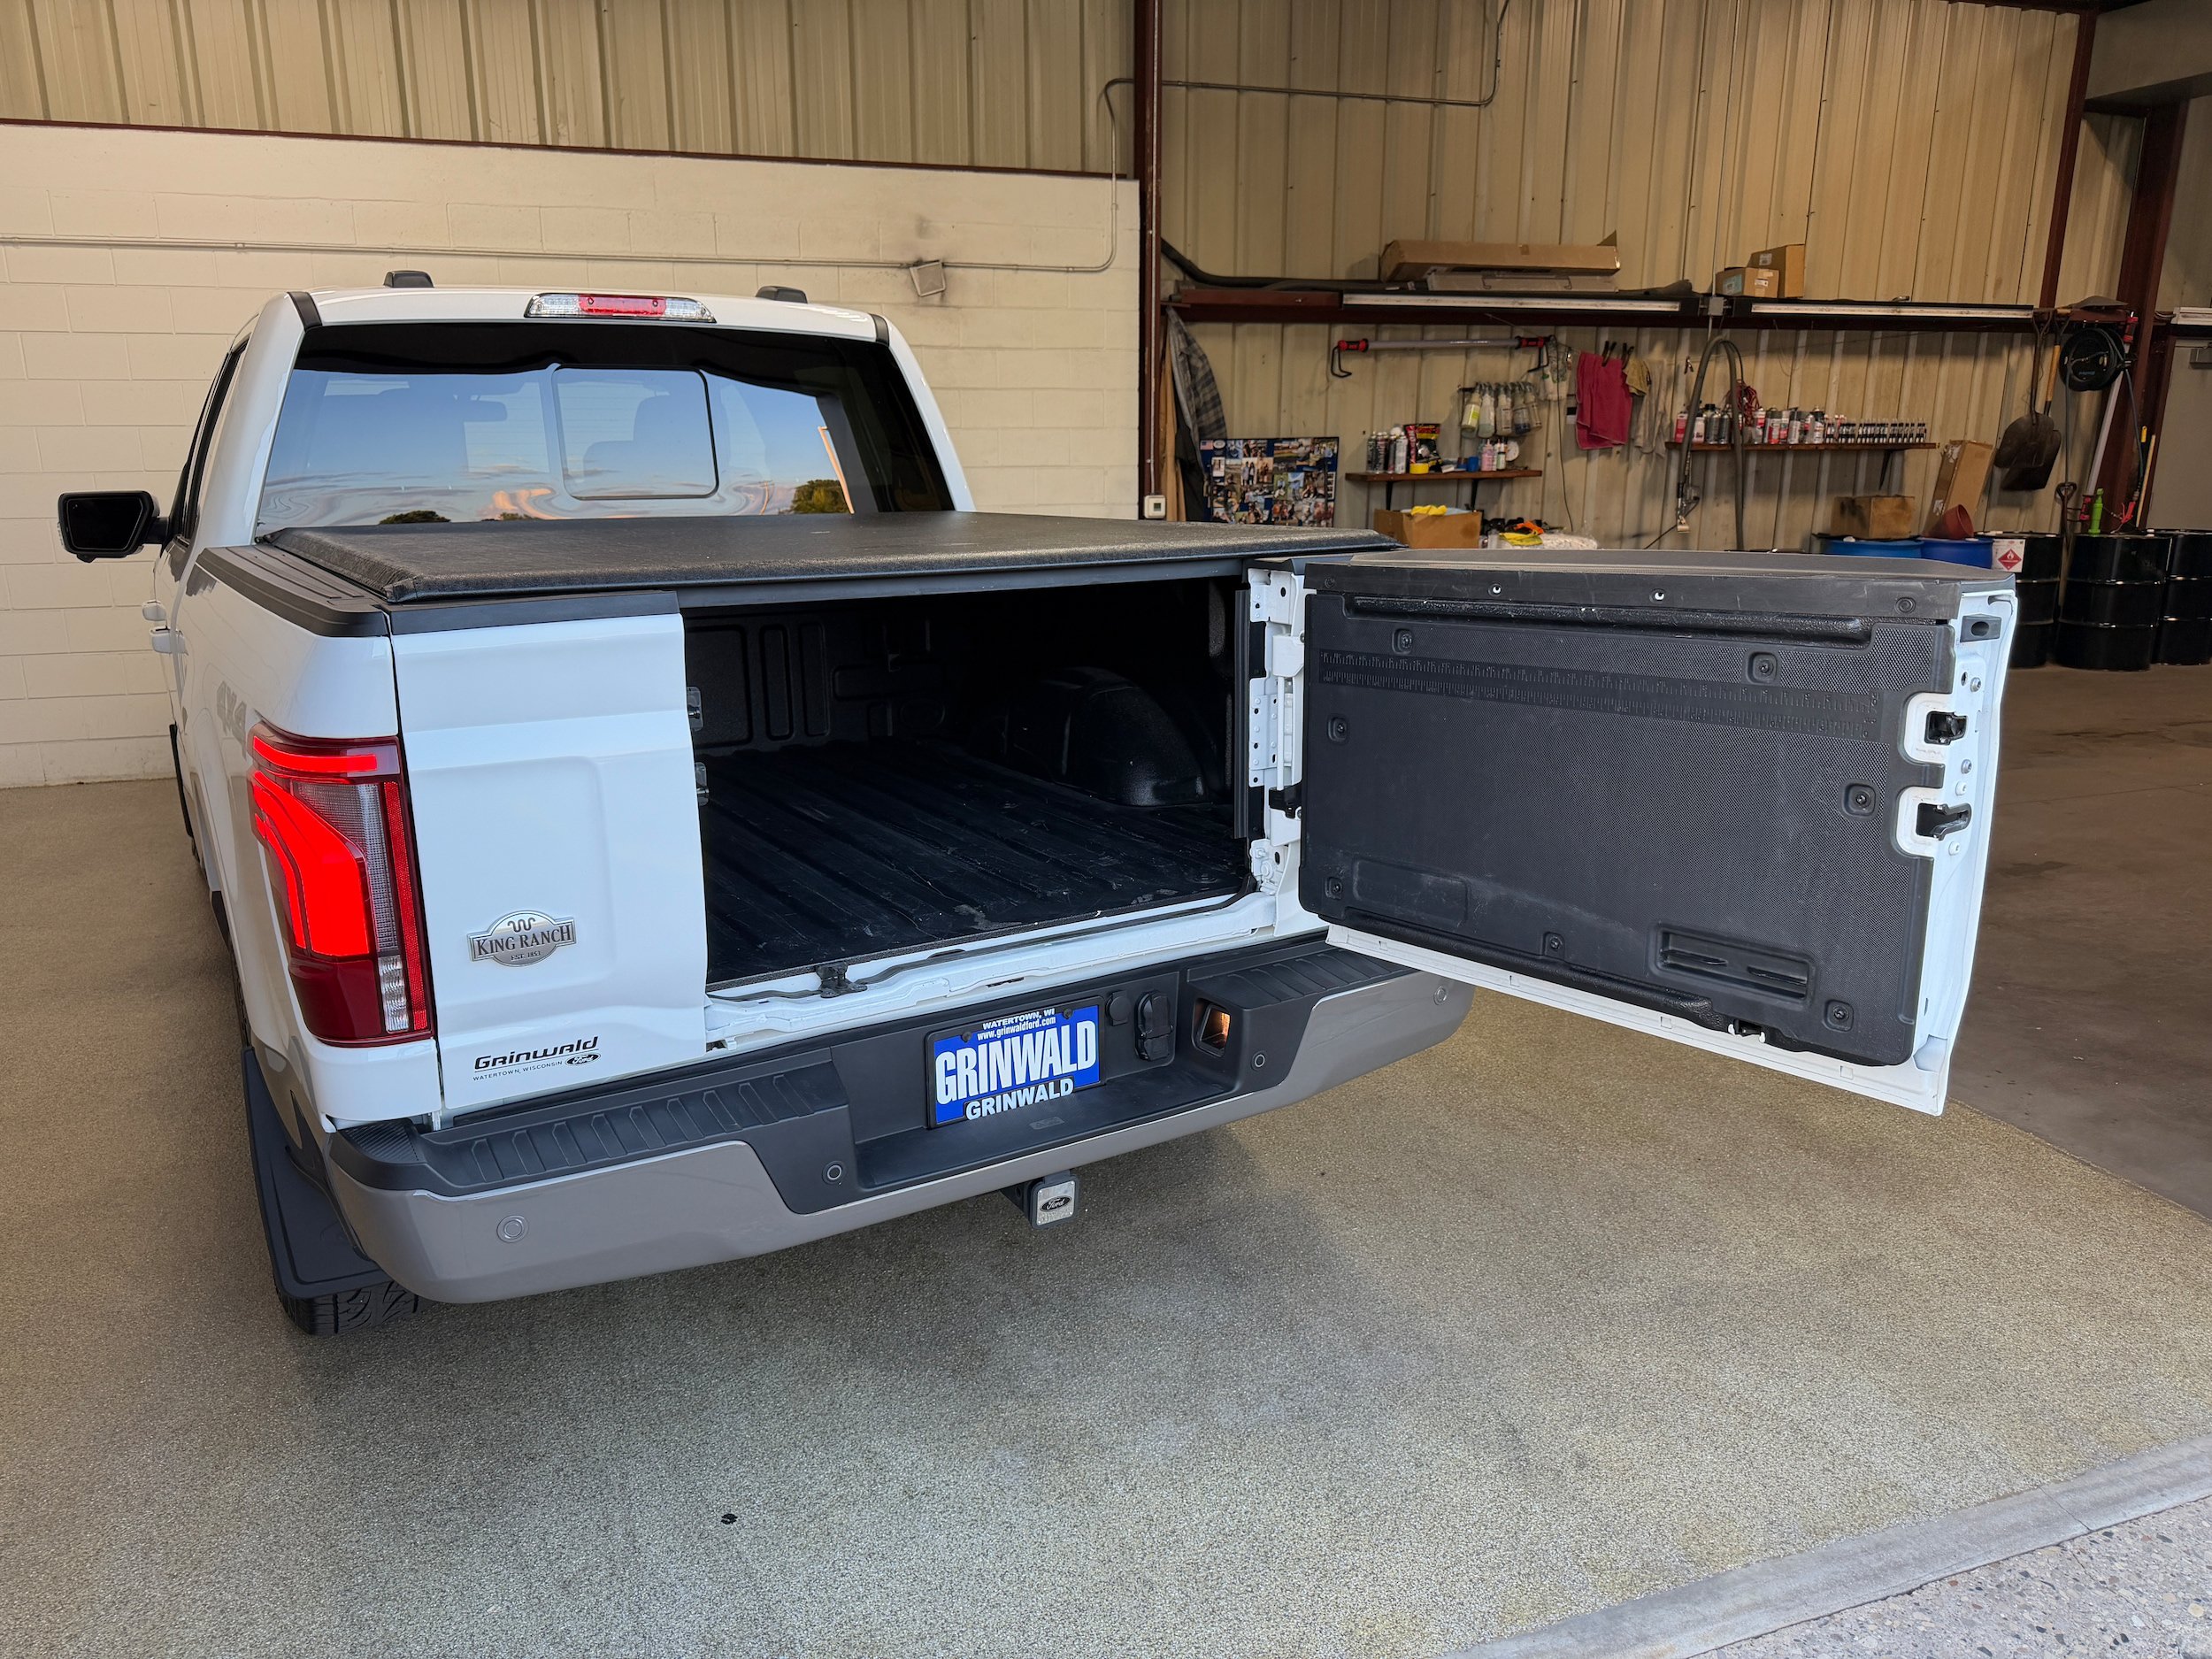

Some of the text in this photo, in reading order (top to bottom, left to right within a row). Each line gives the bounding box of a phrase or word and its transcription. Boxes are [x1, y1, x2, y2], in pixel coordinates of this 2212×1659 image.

[476, 925, 571, 956] KING RANCH
[977, 1017, 1056, 1041] www.grinwaldford.com
[982, 1008, 1056, 1030] WATERTOWN, WI
[522, 1061, 563, 1072] WISCONSIN
[935, 1020, 1096, 1105] GRINWALD
[965, 1078, 1074, 1121] GRINWALD
